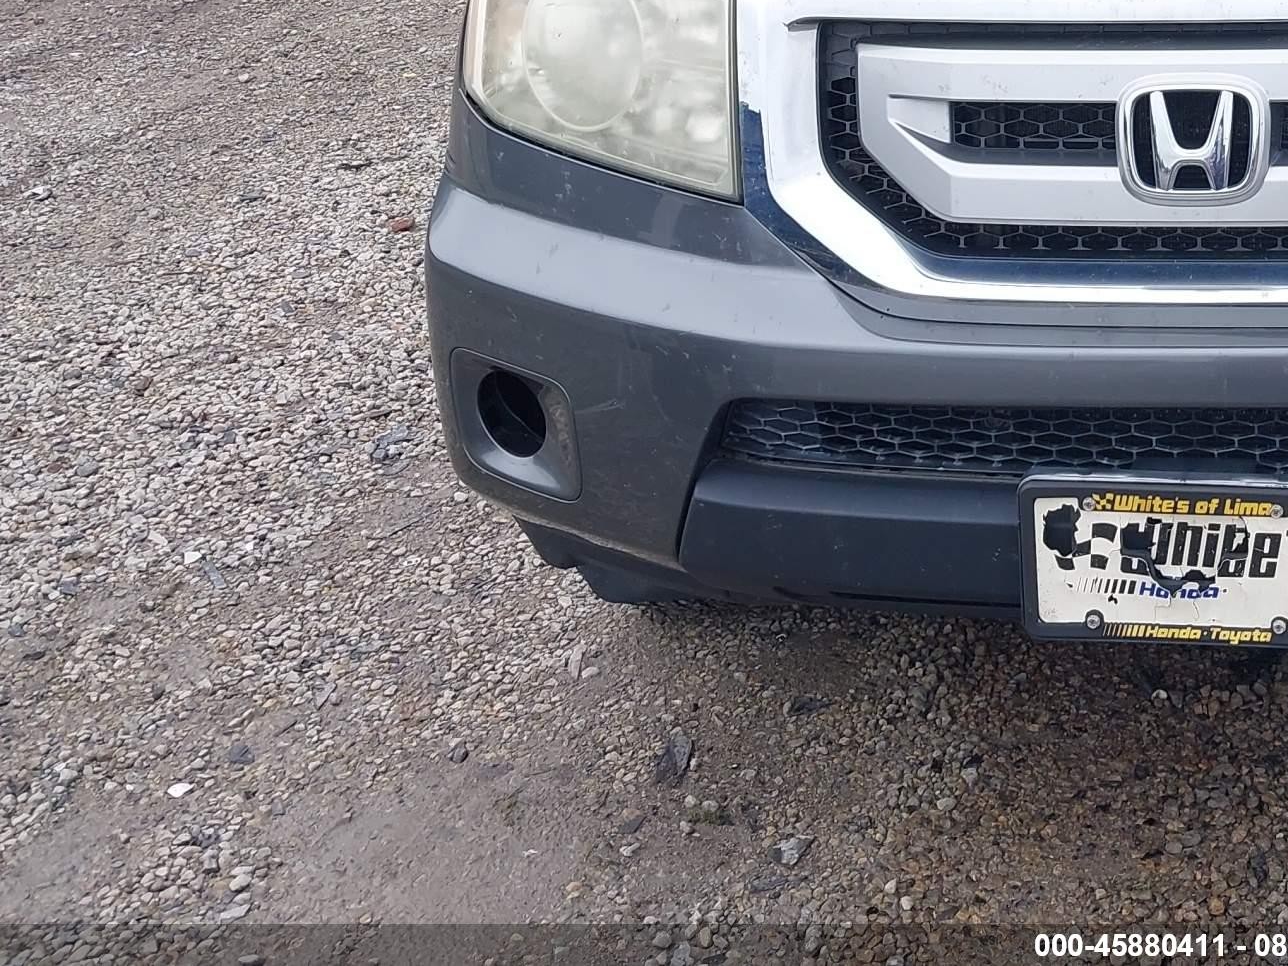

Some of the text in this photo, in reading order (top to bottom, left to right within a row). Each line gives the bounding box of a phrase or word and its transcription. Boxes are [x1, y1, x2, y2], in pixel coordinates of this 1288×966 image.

[1113, 494, 1273, 516] White's of Lima
